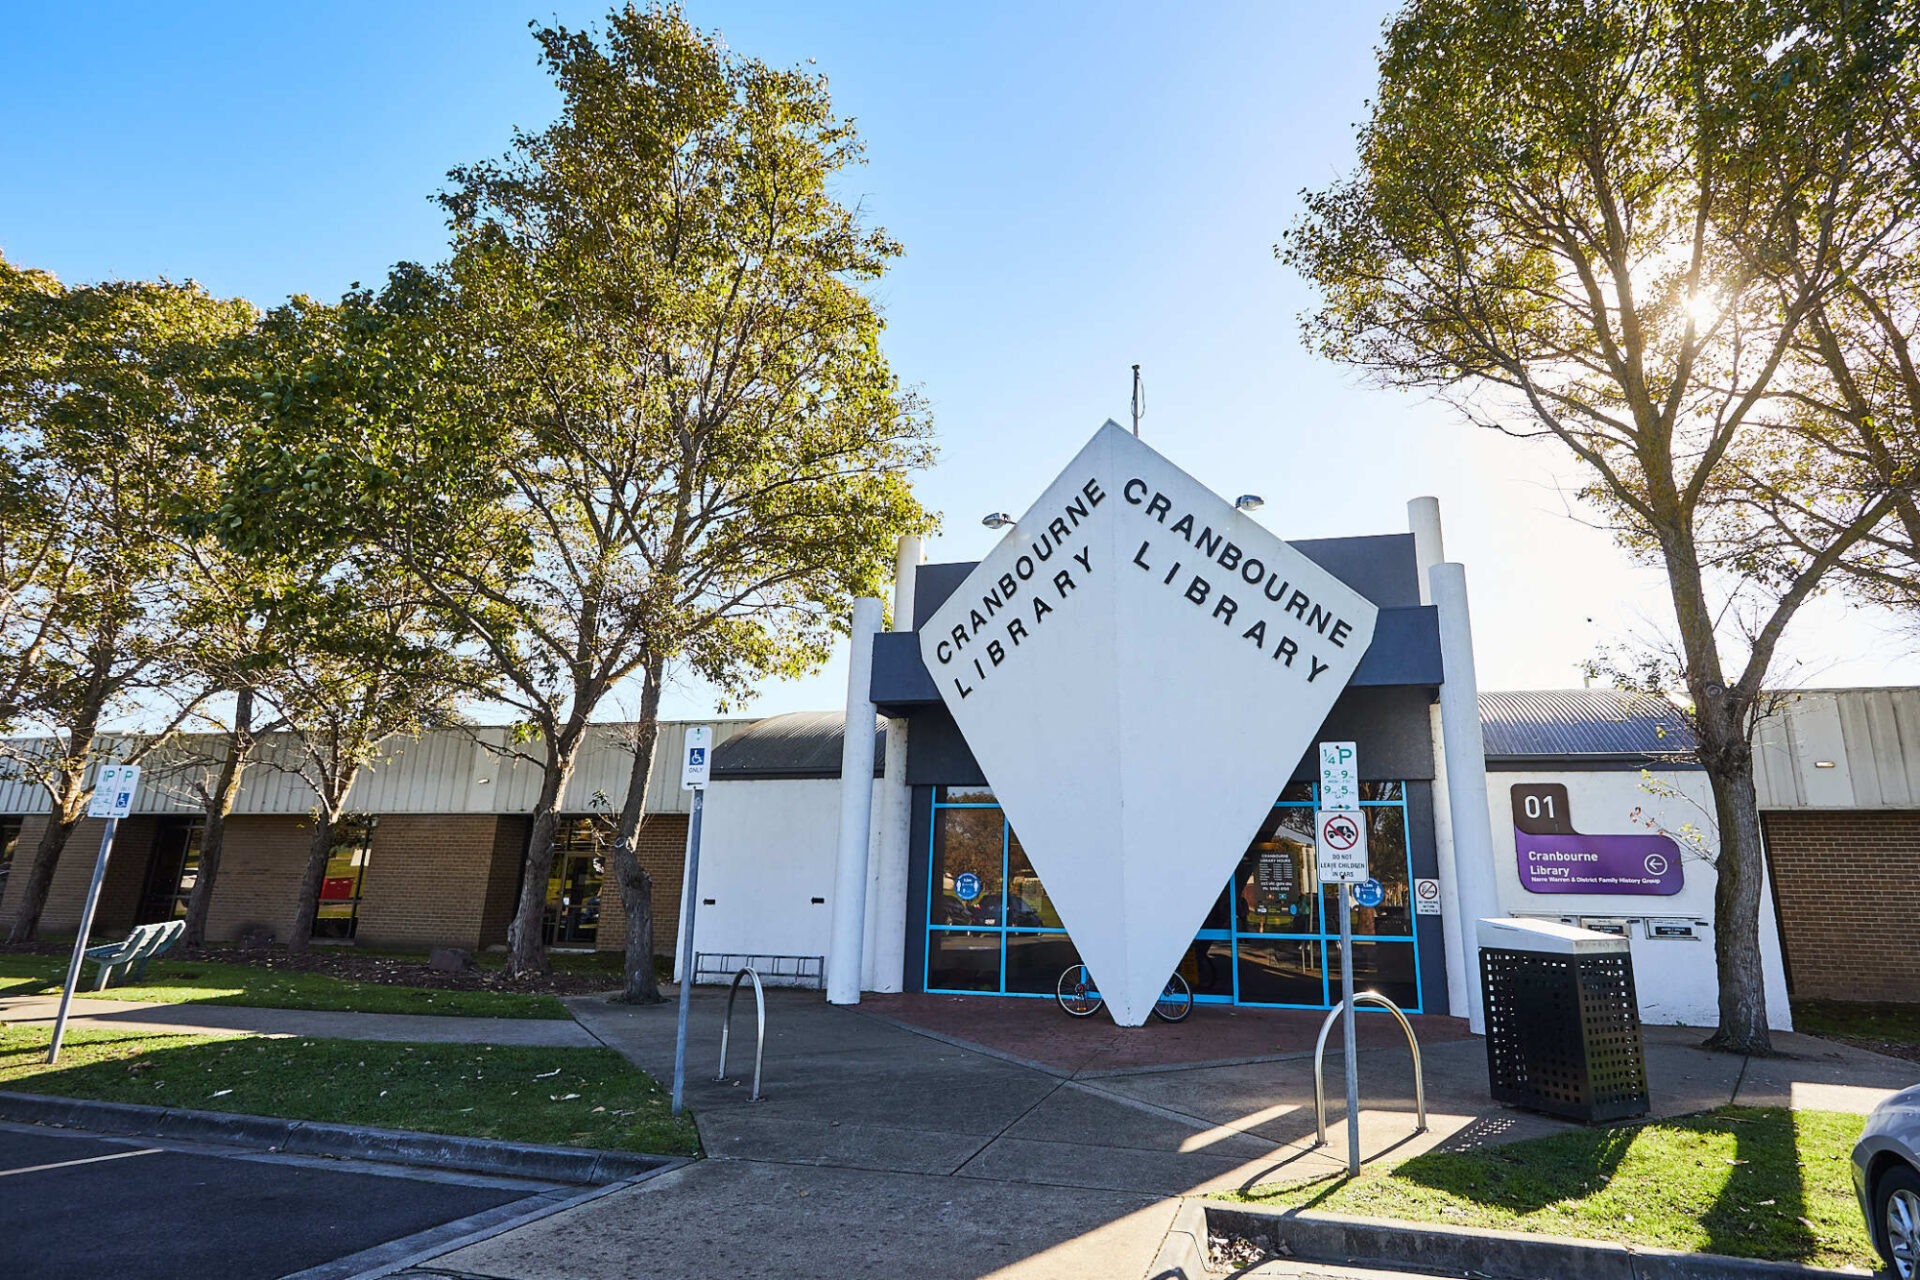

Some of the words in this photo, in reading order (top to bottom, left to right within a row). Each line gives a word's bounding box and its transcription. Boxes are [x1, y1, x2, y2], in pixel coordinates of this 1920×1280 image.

[936, 477, 1106, 665] CRANBOURNE
[954, 545, 1095, 699] LIBRARY
[1123, 478, 1353, 649] CRANBOURNE
[1133, 541, 1329, 683] LIBRARY
[1524, 795, 1555, 819] 01
[1528, 851, 1598, 862] Cranbourne
[1530, 865, 1570, 877] Library
